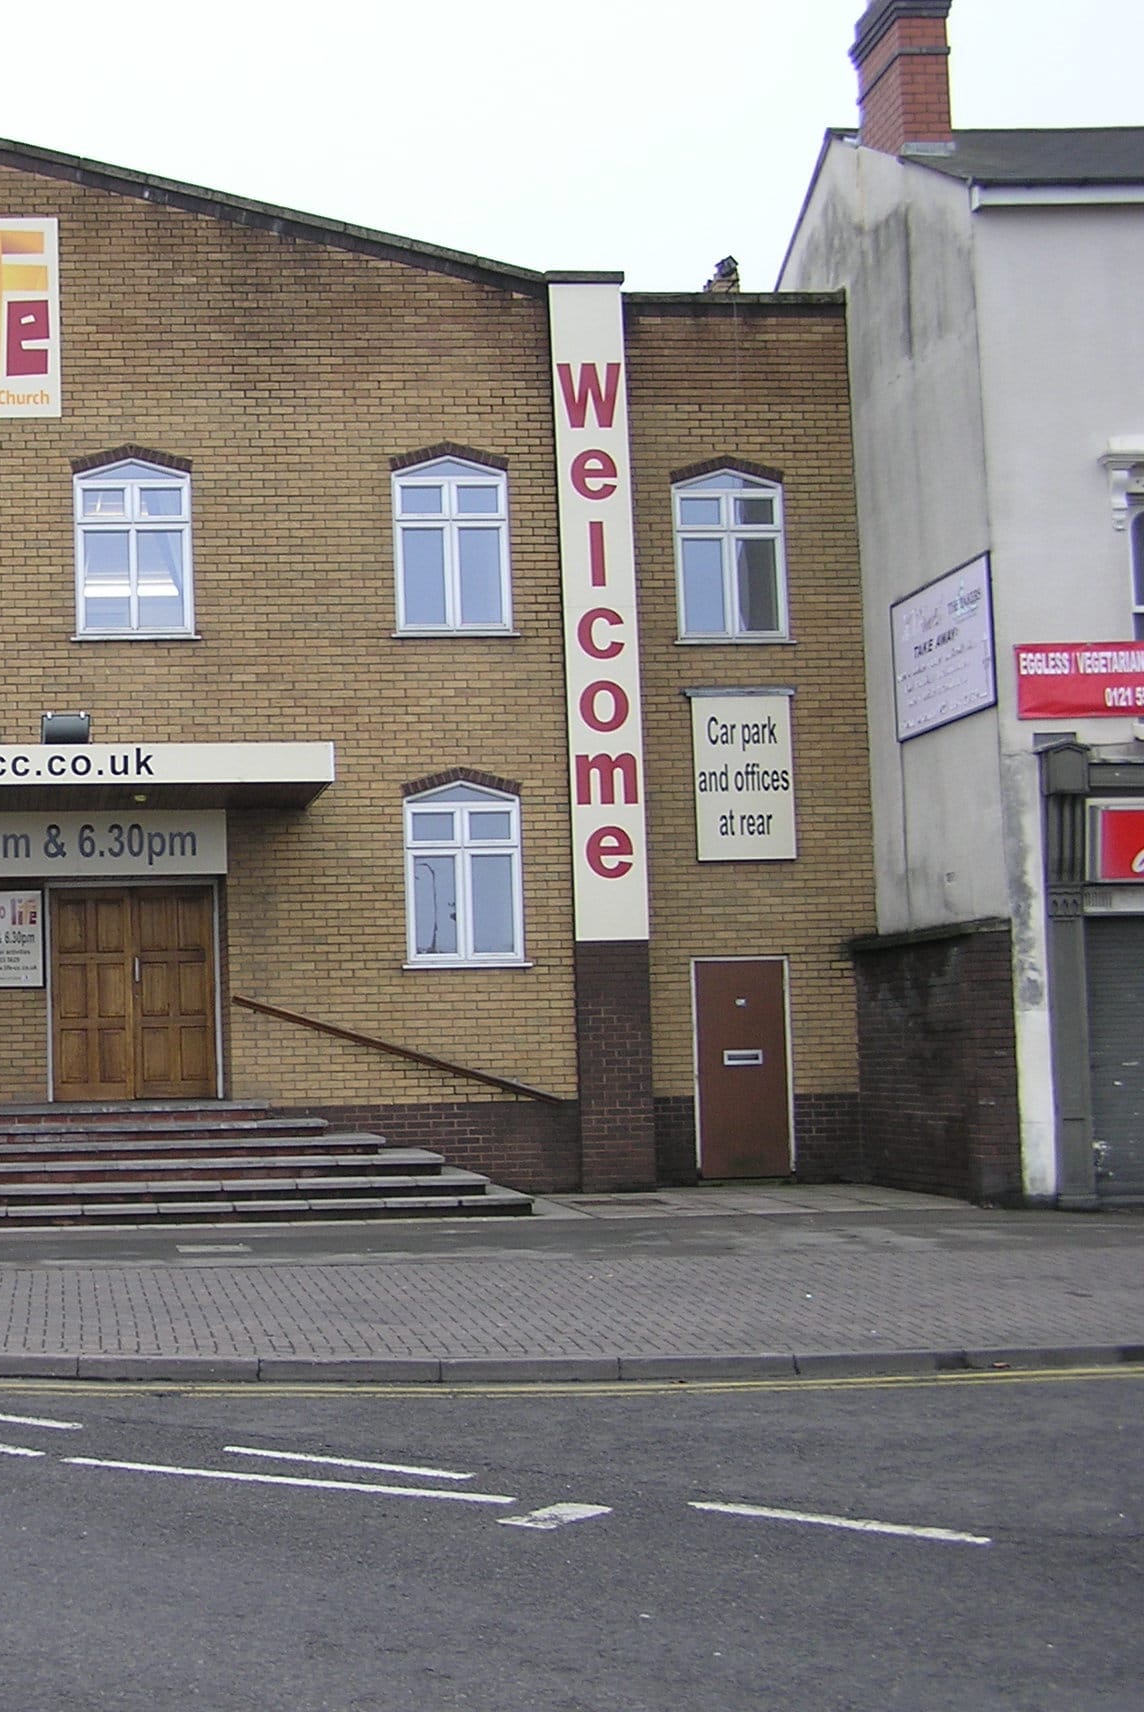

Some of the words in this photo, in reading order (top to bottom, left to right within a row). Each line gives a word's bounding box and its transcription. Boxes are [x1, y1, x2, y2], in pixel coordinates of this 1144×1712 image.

[556, 362, 639, 879] Welcome
[1019, 652, 1070, 675] EGGLESS
[1105, 687, 1133, 707] 0121
[707, 716, 736, 746] Car
[741, 715, 778, 751] park
[698, 763, 729, 792] and
[734, 762, 790, 792] offices
[719, 809, 735, 836] at
[740, 812, 773, 836] rear
[42, 823, 67, 858] &
[78, 822, 198, 865] 6.30pm
[4, 931, 35, 946] 6.30pm
